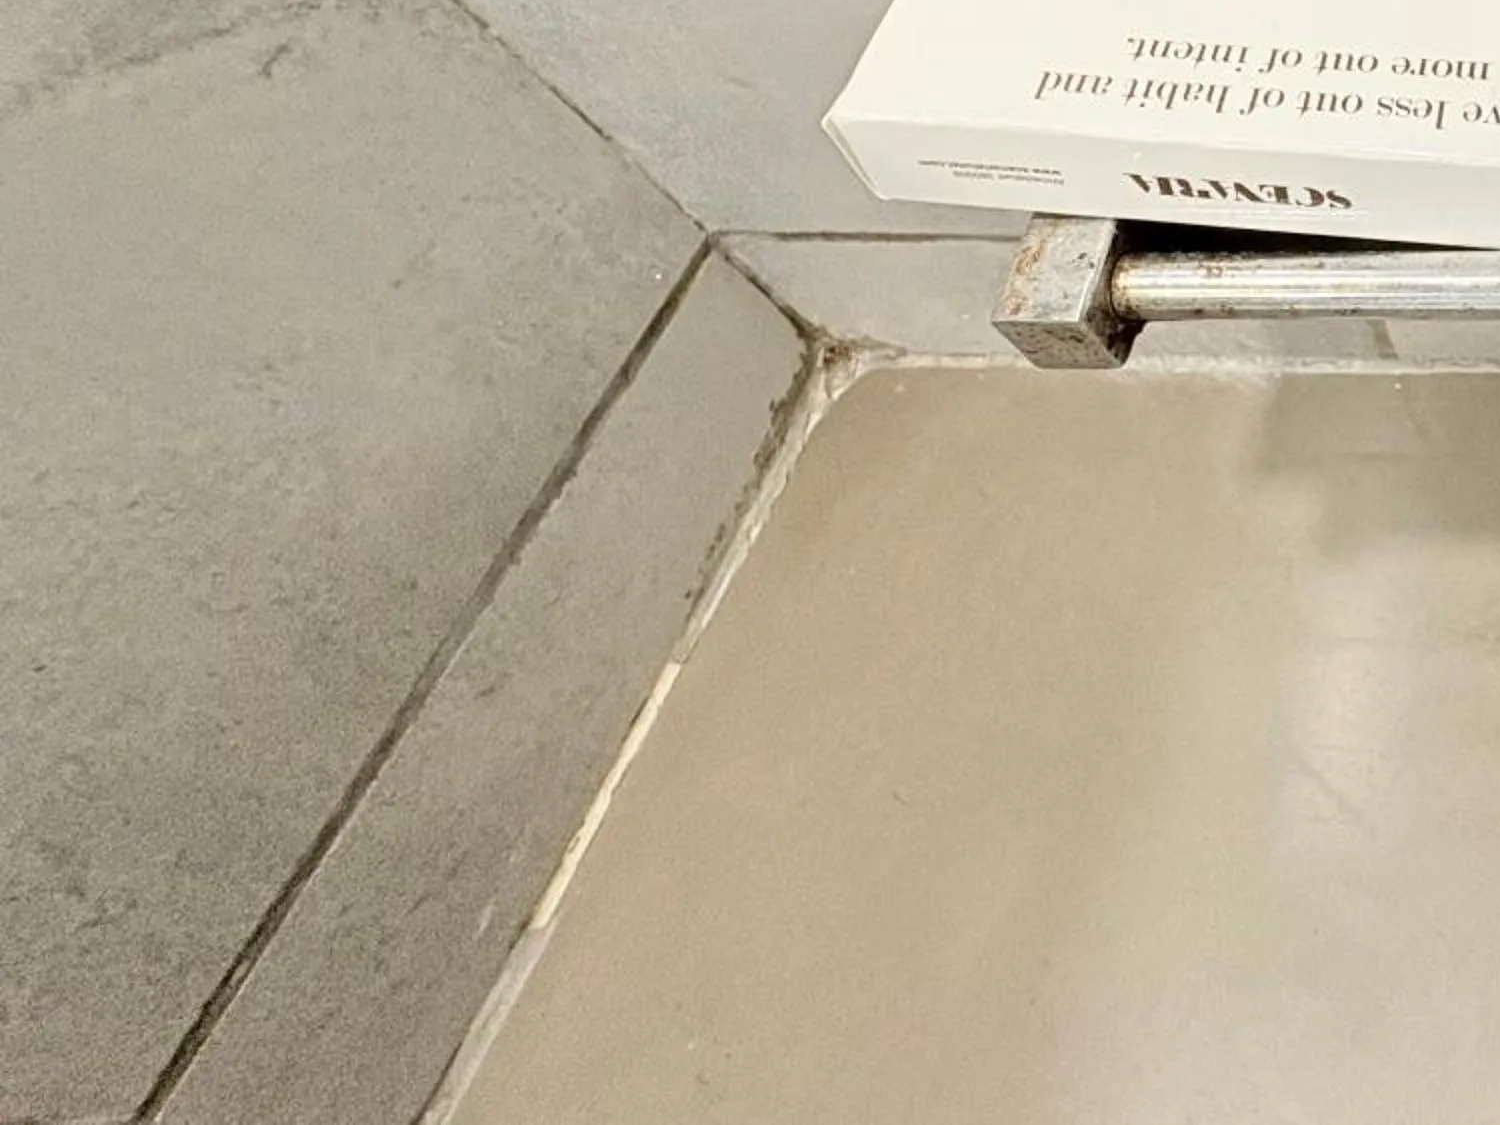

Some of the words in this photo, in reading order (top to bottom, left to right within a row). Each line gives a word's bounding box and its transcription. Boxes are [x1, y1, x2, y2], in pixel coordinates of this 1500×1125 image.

[1126, 37, 1248, 73] intent.
[1258, 47, 1303, 73] of
[1312, 51, 1379, 77] out
[1391, 56, 1490, 83] more
[1034, 70, 1112, 100] and
[1120, 78, 1230, 114] habit
[1239, 86, 1285, 115] of
[1296, 90, 1364, 120] out
[1375, 95, 1448, 130] less
